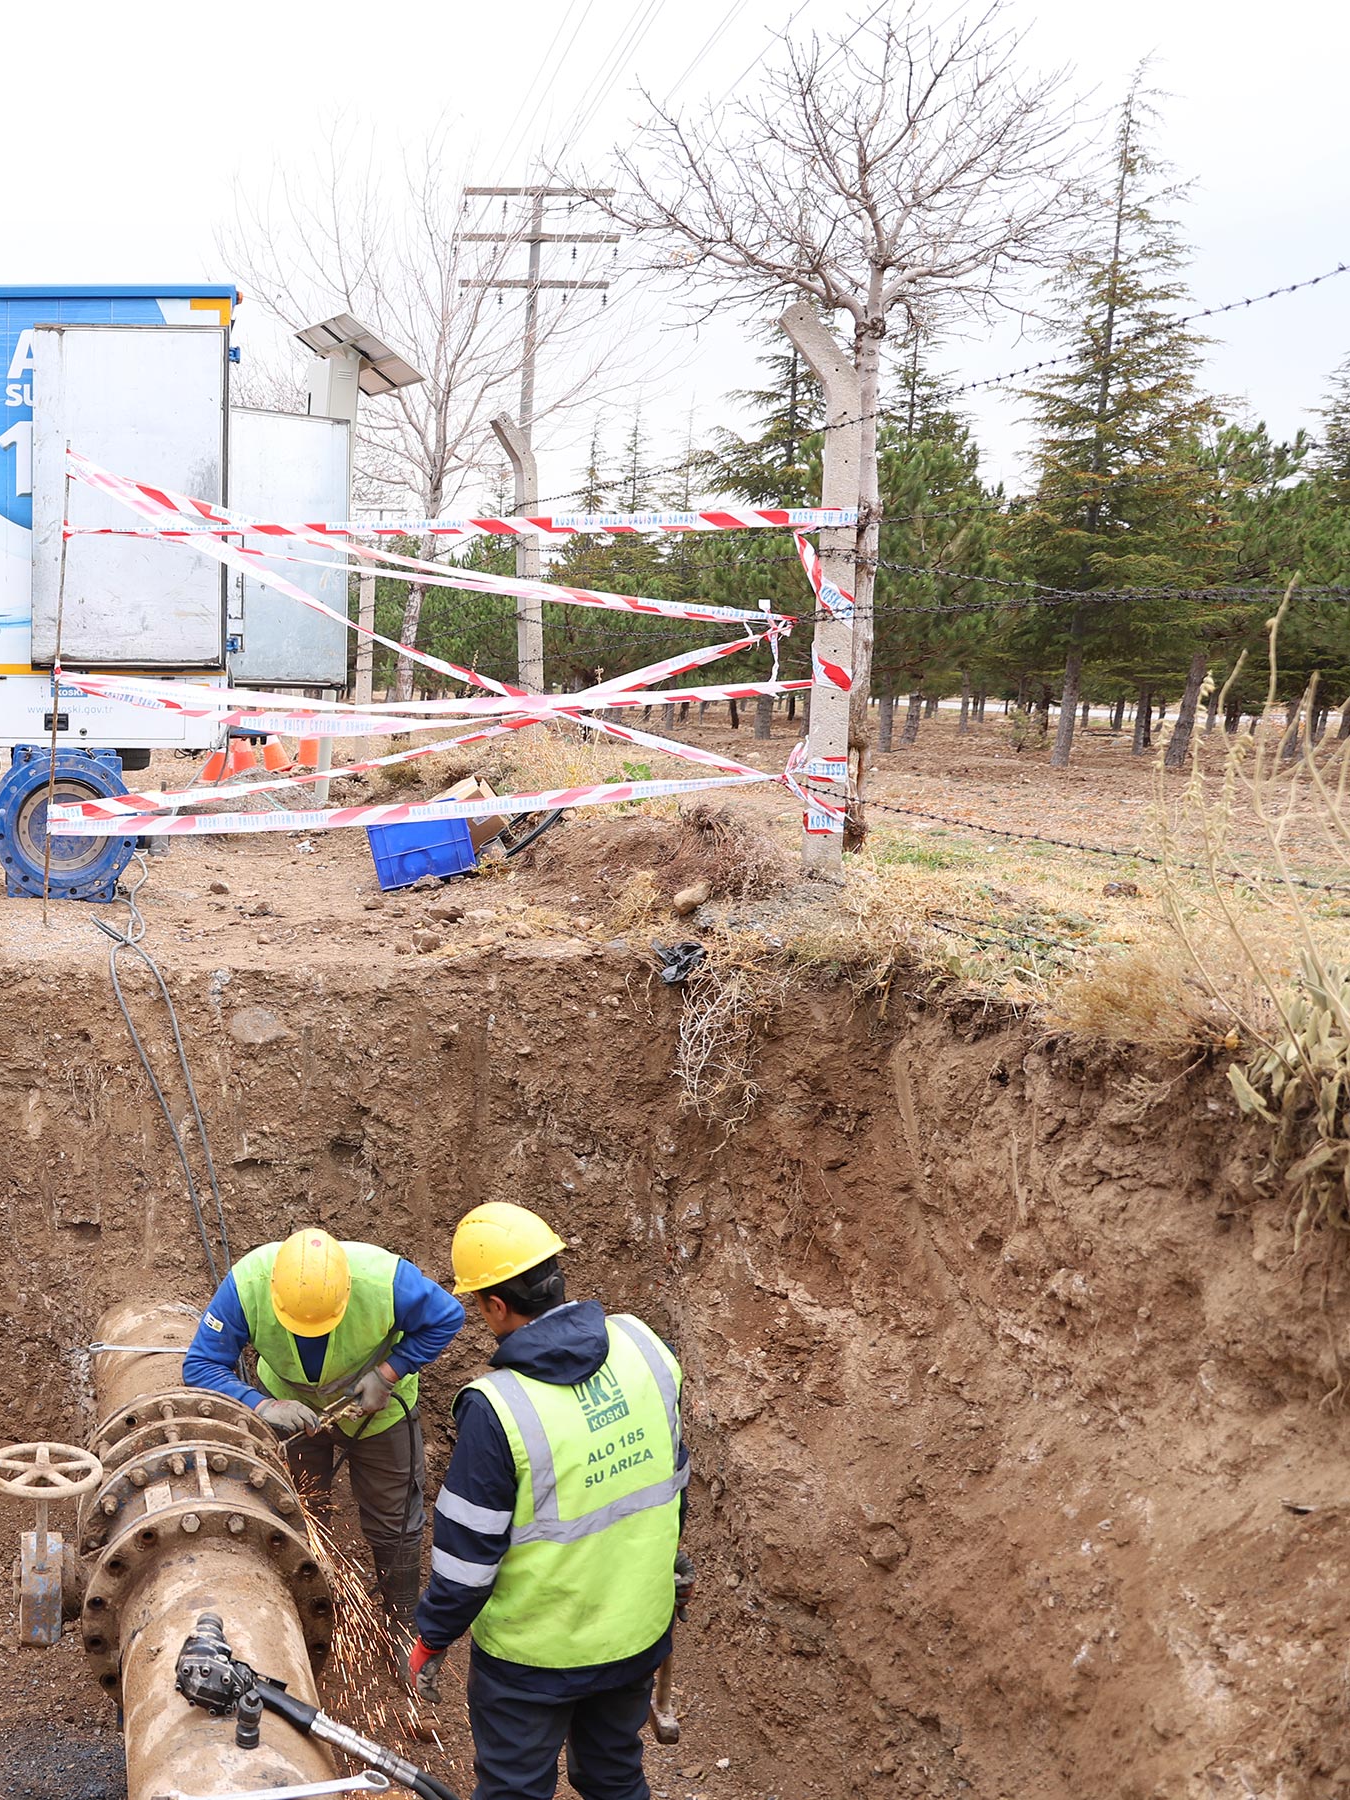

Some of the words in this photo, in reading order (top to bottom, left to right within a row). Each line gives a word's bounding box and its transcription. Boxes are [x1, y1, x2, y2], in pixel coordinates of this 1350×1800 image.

[584, 1375, 612, 1407] K
[587, 1442, 615, 1466] ALO
[618, 1427, 645, 1449] 185
[585, 1470, 605, 1489] SU
[609, 1448, 654, 1478] ARIZA
